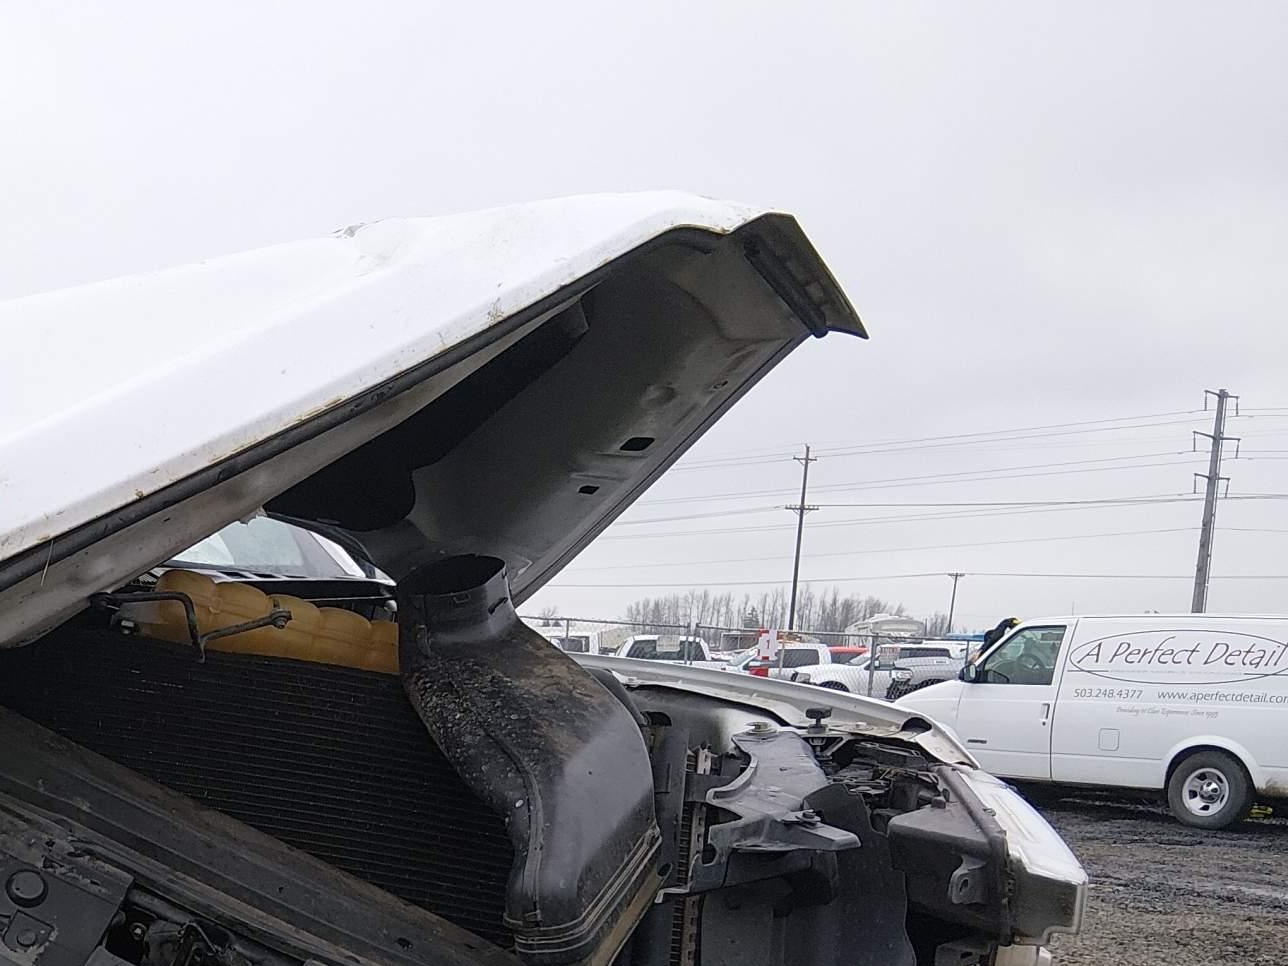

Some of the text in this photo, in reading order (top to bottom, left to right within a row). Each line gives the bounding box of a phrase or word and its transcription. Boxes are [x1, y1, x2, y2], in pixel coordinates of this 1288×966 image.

[1076, 635, 1288, 669] A Perfect Detail
[1073, 688, 1143, 699] 503.248.4377
